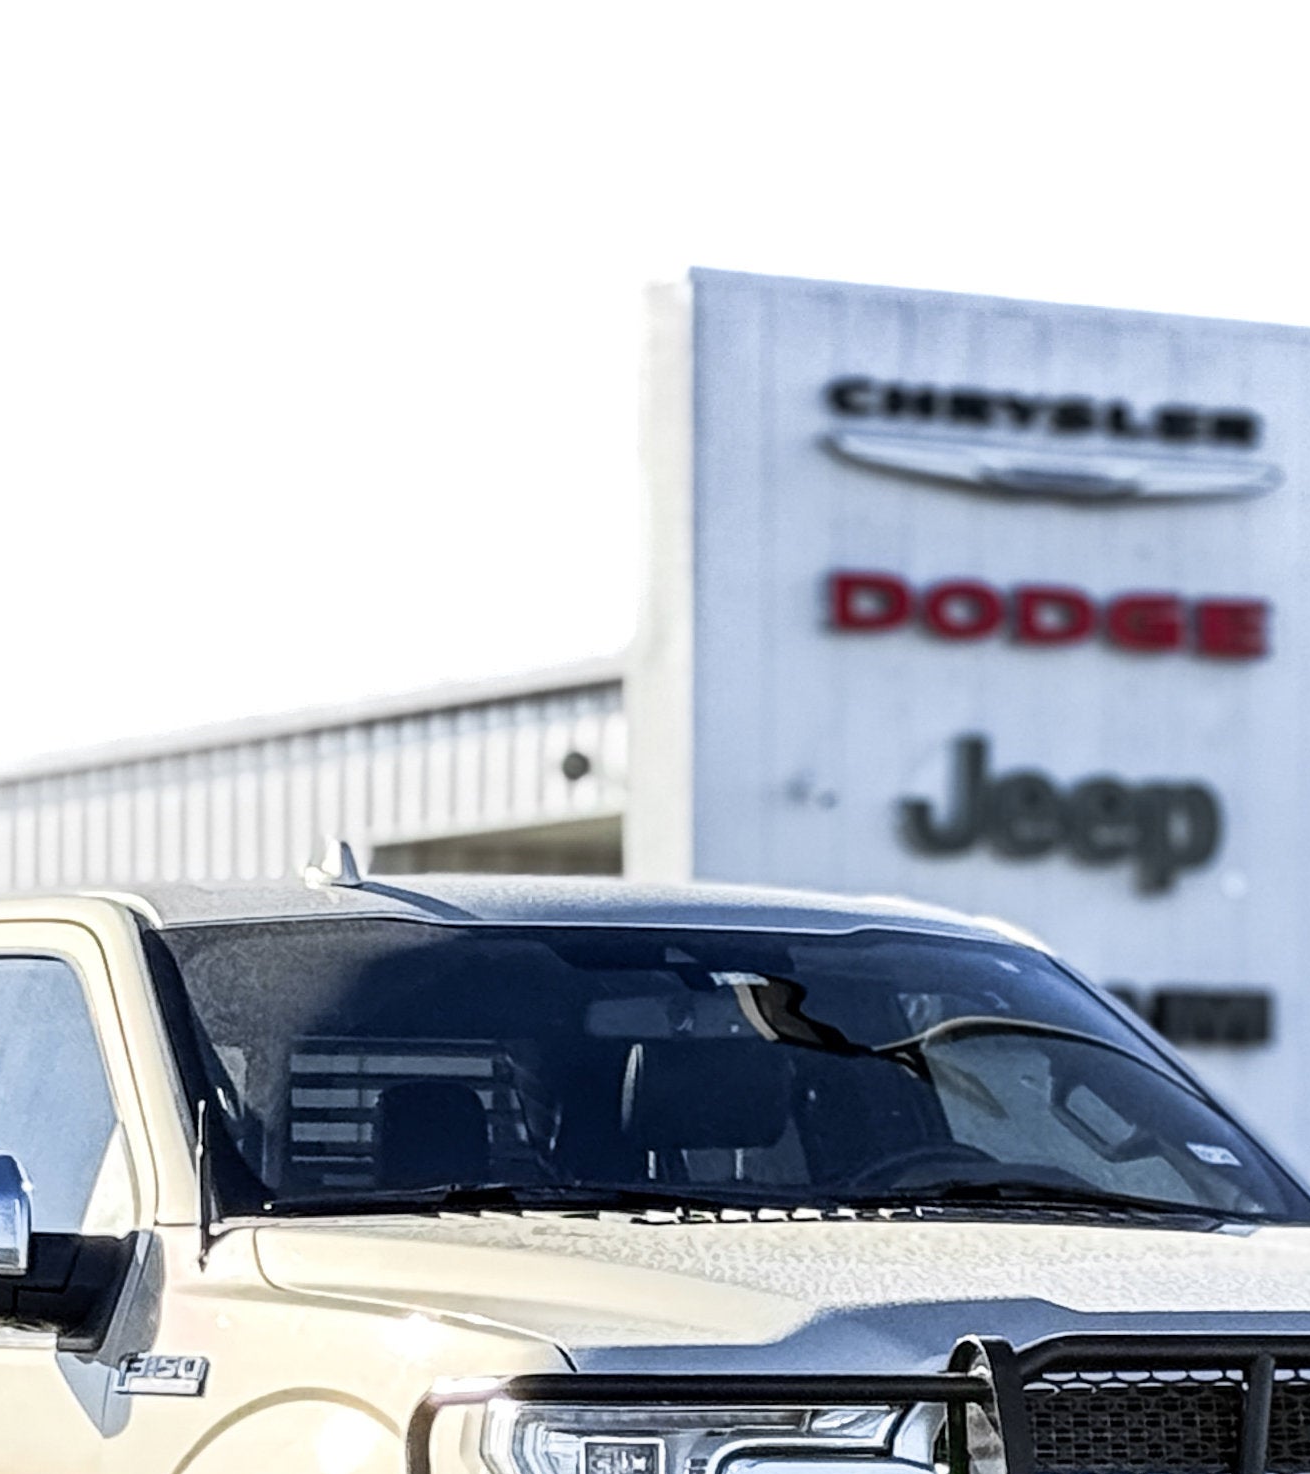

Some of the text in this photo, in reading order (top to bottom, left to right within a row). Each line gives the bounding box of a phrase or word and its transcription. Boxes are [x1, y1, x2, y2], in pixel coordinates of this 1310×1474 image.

[826, 377, 1261, 447] CHRYSLER
[828, 572, 1270, 660] DODGE
[900, 734, 1222, 894] Jeep
